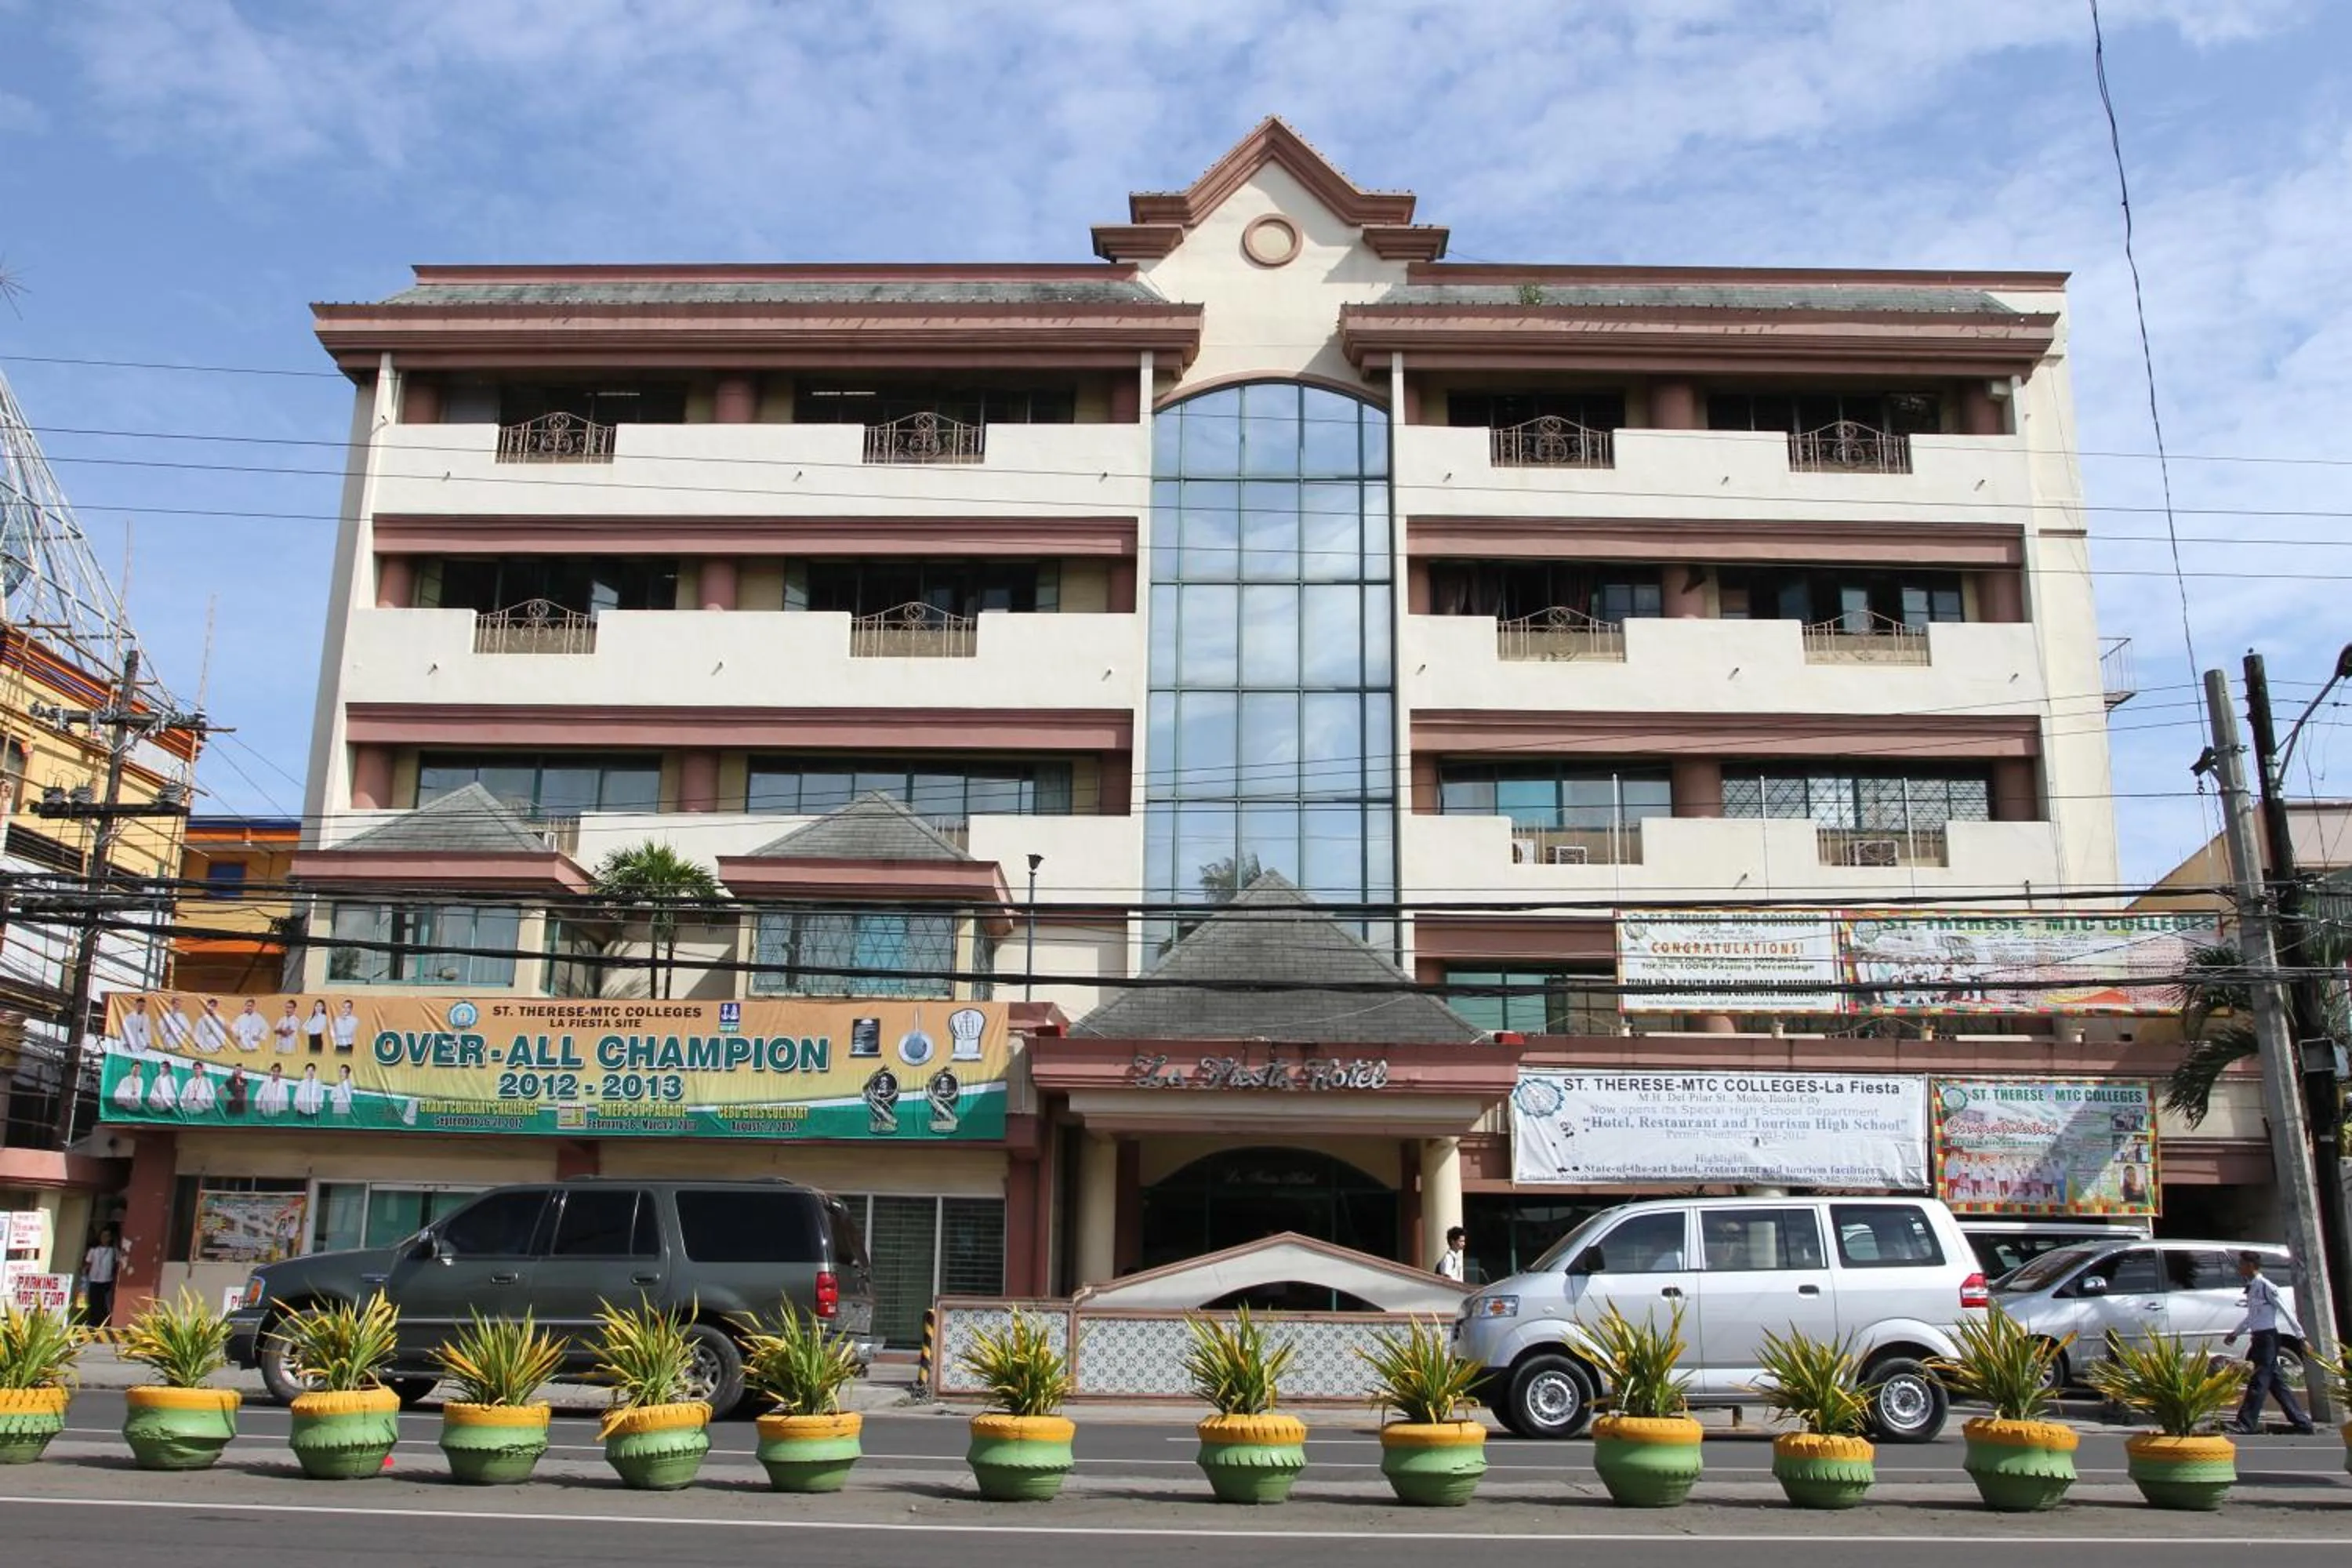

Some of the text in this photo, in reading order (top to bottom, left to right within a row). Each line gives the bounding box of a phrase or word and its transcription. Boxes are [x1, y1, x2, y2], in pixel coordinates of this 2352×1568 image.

[1926, 917, 2024, 931] THERESE
[2045, 916, 2096, 931] MTC
[2103, 916, 2216, 931] COLLEGES
[1651, 942, 1803, 954] CONGRATULATIONS!
[492, 1006, 702, 1018] ST. THERESE-MTC COLLEGES
[549, 1019, 641, 1028] LA FIESTA SITE
[373, 1031, 585, 1067] OVER-ALL
[596, 1035, 831, 1072] CHAMPION
[1133, 1054, 1388, 1091] La Fiesta Hotel
[498, 1073, 579, 1098] 2012
[600, 1073, 684, 1101] 2013
[1563, 1079, 1900, 1094] ST. THERESE-MTC COLLEGES-La Fiesta
[1972, 1089, 2143, 1103] ST. THERESE MTC COLLEGES
[1590, 1105, 1616, 1114] Now
[1621, 1107, 1657, 1117] opens
[1681, 1105, 1726, 1117] Special
[1762, 1106, 1802, 1116] School
[1806, 1107, 1879, 1119] Department
[1639, 1117, 1717, 1129] Restaurant
[1722, 1118, 1748, 1129] and
[1754, 1118, 1811, 1130] Tourism
[1816, 1119, 1849, 1133] High
[17, 1276, 59, 1290] PARKING
[44, 1292, 65, 1305] FOR
